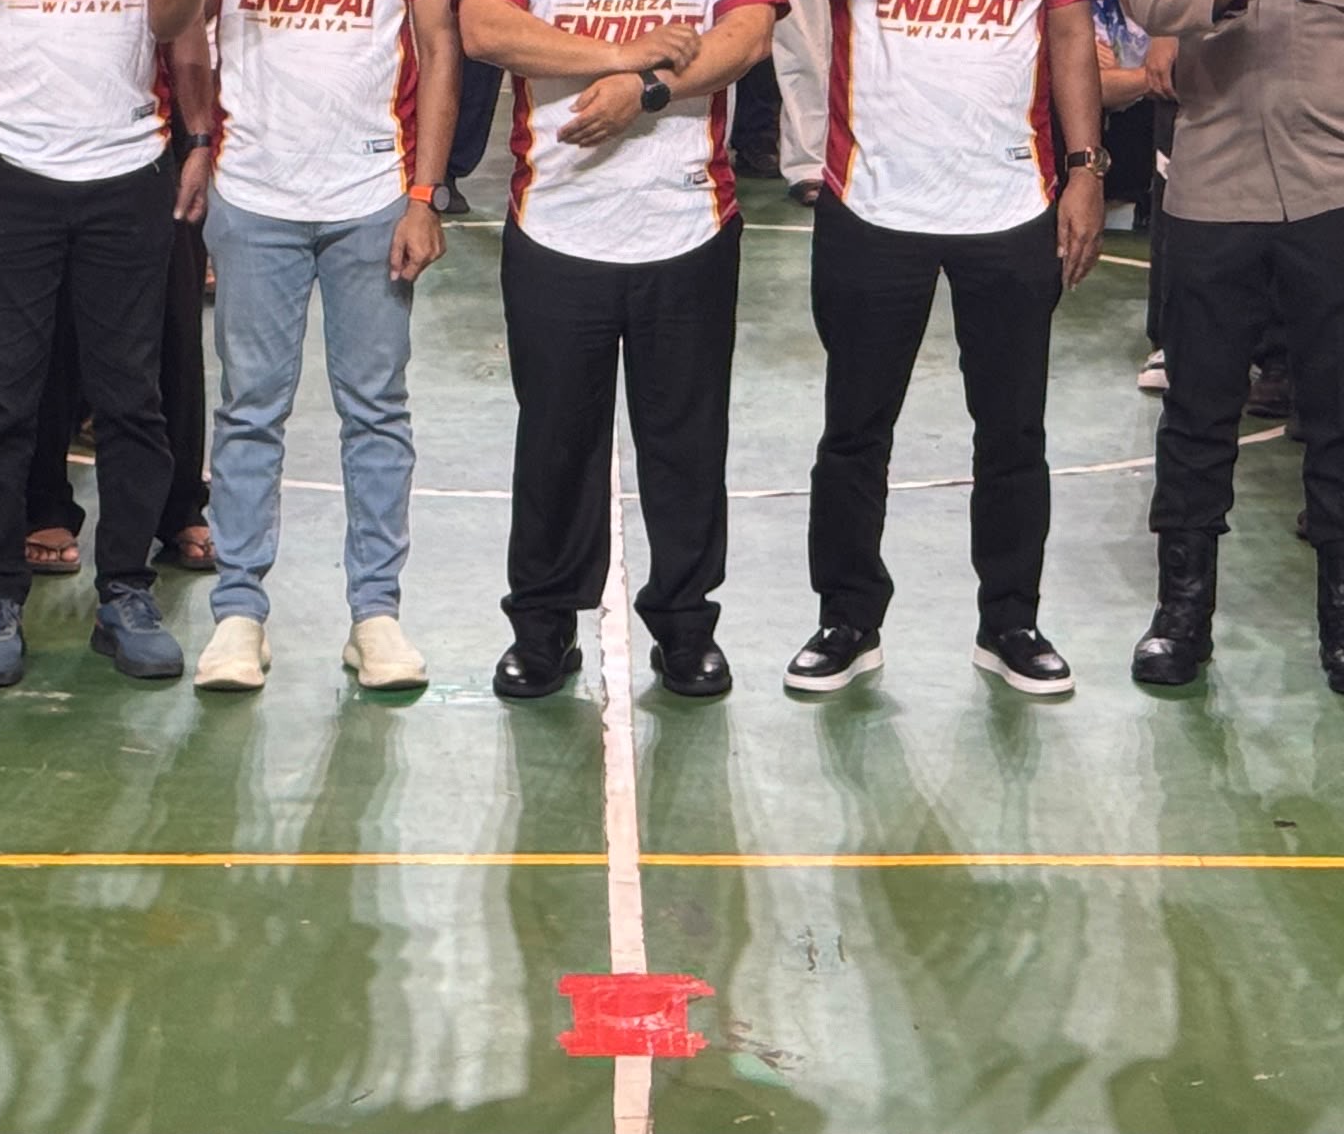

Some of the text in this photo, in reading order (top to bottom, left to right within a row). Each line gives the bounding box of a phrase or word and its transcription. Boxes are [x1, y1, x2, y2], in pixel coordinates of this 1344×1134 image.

[41, 0, 123, 13] WIJAYA
[268, 15, 349, 33] WIJAYA
[906, 25, 991, 41] WIJAYA
